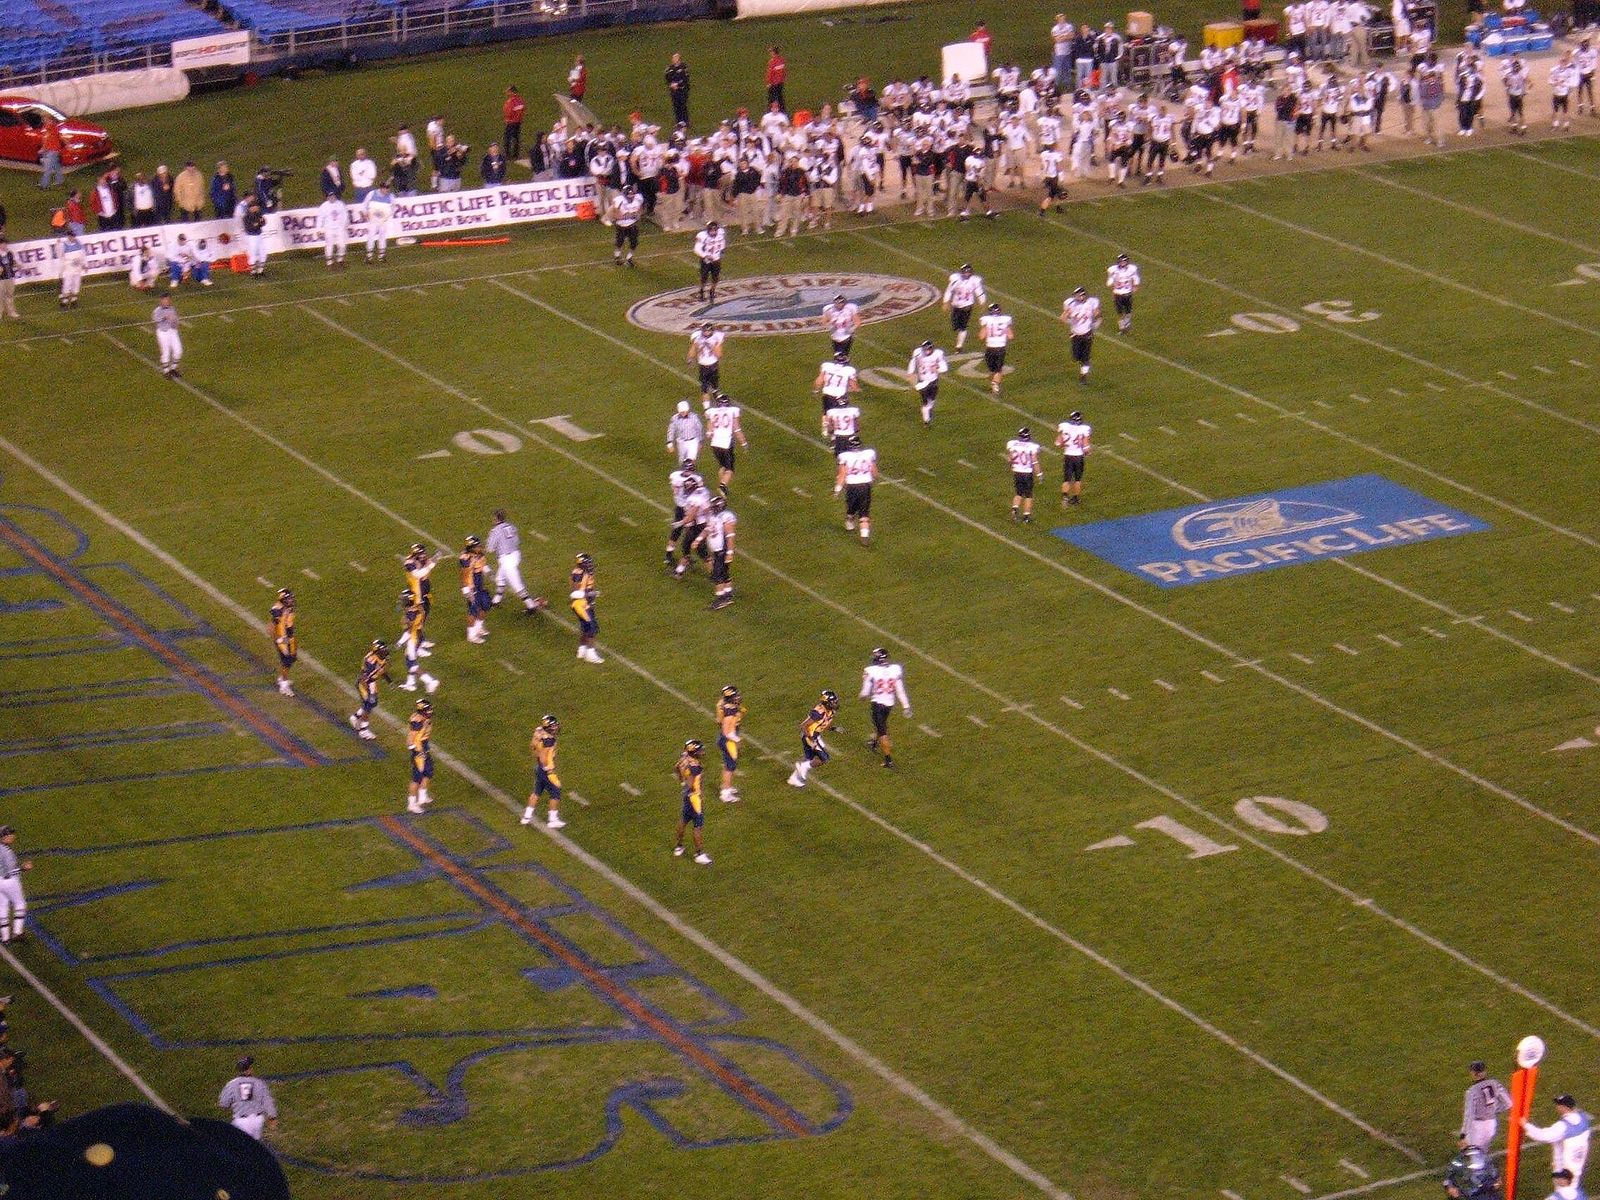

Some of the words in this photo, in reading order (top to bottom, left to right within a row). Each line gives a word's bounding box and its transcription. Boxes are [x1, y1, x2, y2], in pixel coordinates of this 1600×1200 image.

[393, 199, 454, 218] PACIFIC
[457, 194, 495, 212] LIFE
[500, 187, 561, 206] PACIFIC
[509, 206, 560, 218] HOLIDAY
[401, 216, 453, 231] HOLIDAY
[457, 213, 490, 225] BOWL
[122, 234, 161, 252] LIFE
[826, 373, 843, 387] 77
[451, 414, 606, 454] 10
[1136, 534, 1357, 583] PACIFIC
[1340, 513, 1471, 545] LIFE
[1134, 795, 1330, 859] 10
